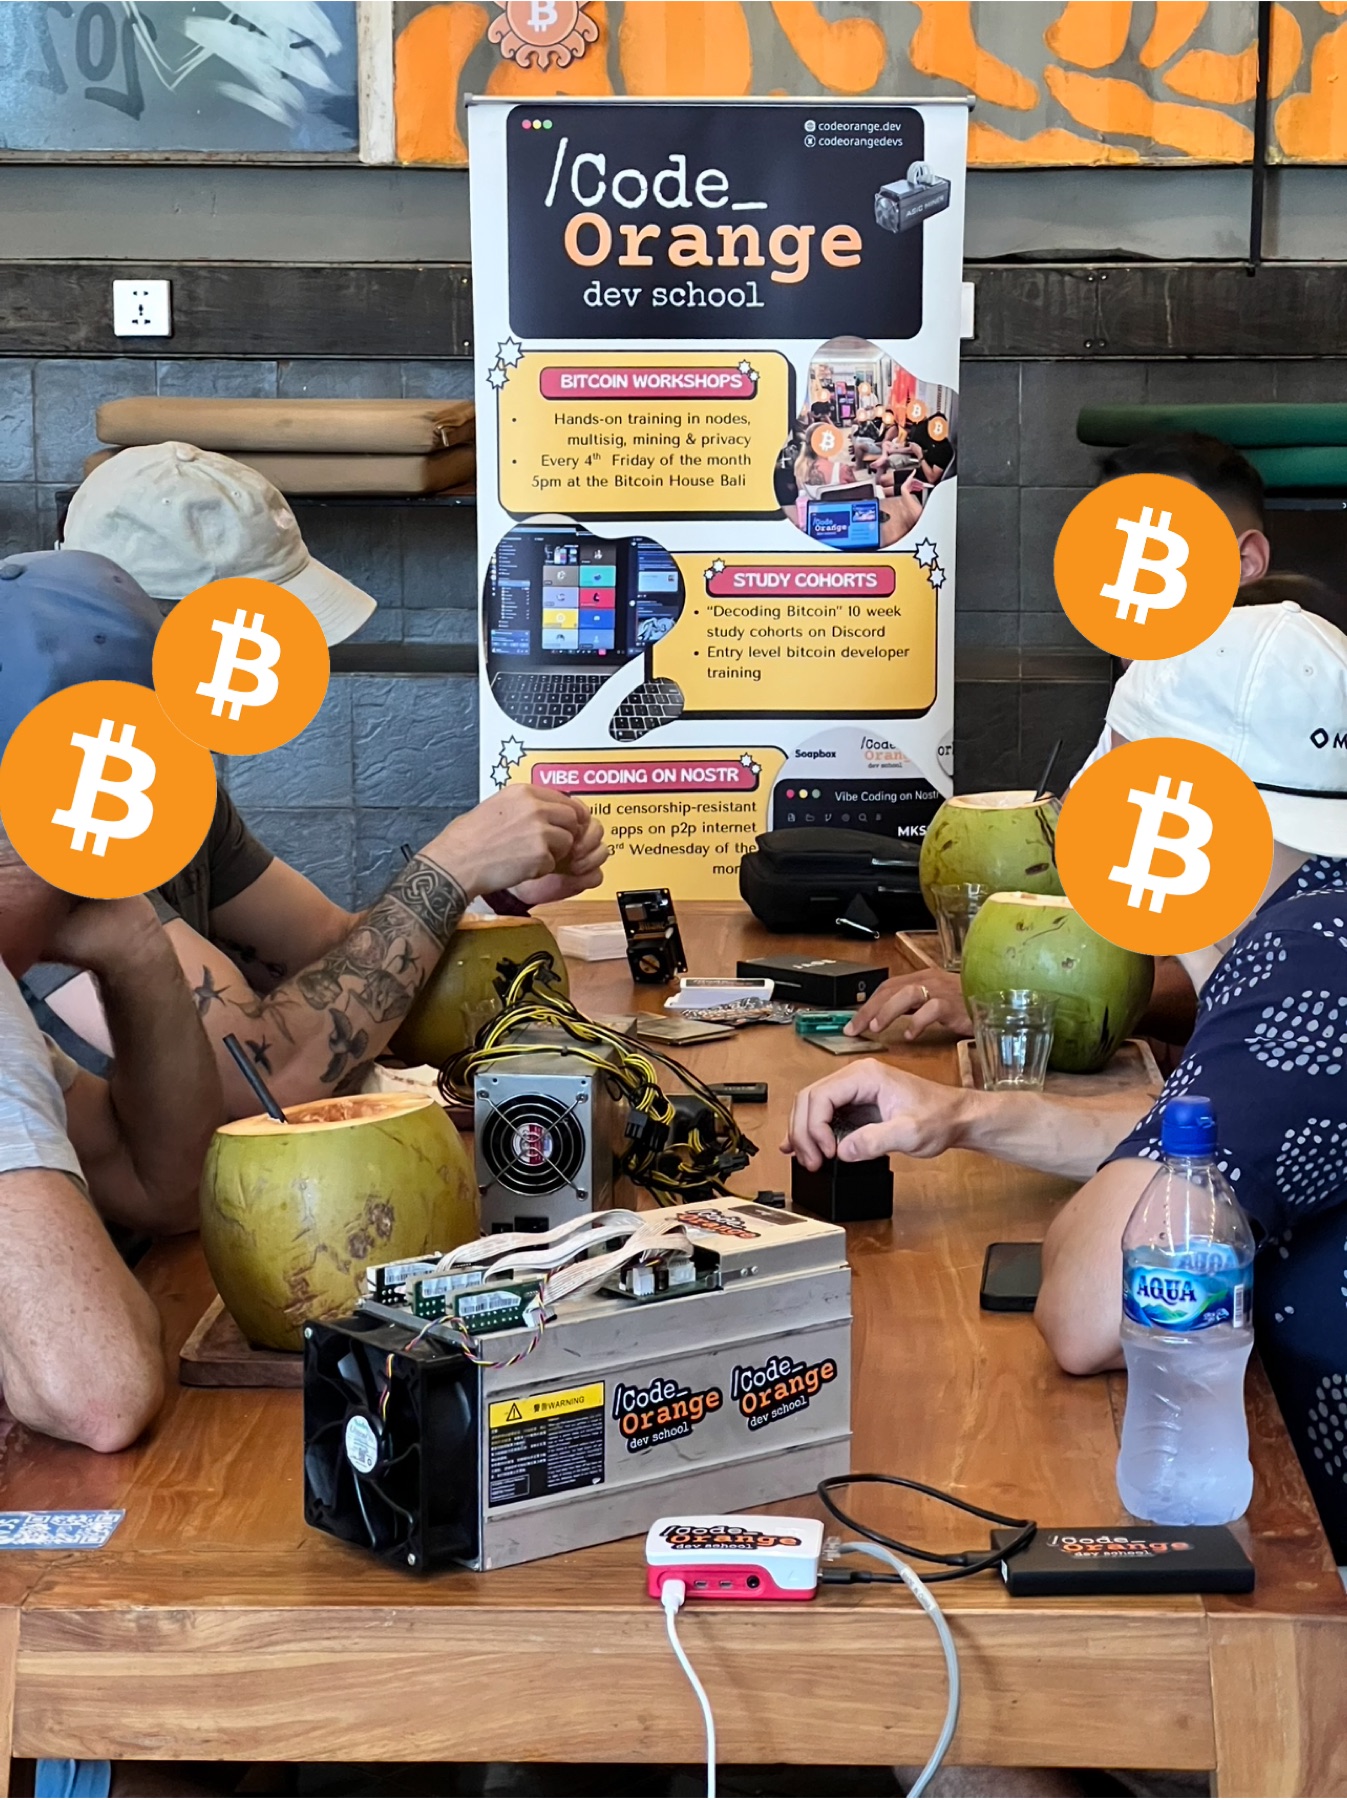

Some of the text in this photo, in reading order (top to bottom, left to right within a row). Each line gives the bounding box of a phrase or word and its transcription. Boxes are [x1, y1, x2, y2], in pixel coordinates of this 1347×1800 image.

[818, 120, 902, 134] codeorange.dev
[818, 135, 903, 149] codeorangedevs
[544, 136, 768, 211] /Code_
[563, 211, 863, 284] Orange
[583, 280, 765, 308] dev school
[560, 372, 744, 390] BITCOIN WORKSHOPS
[554, 412, 751, 430] Hands-on training in nodes,
[566, 432, 752, 450] multisig, mining & privacy
[541, 454, 580, 470] Every
[611, 453, 656, 470] Friday
[659, 453, 675, 467] of
[679, 453, 702, 467] the
[706, 453, 752, 467] month
[531, 474, 747, 491] 5pm at the Bitcoin House Bali
[733, 572, 878, 588] STUDY COHORTS
[847, 605, 861, 618] 10
[866, 604, 902, 618] week
[706, 625, 886, 642] study cohorts on Discord
[706, 645, 910, 662] Entry level bitcoin developer
[706, 665, 762, 682] training
[795, 749, 836, 760] Soapbox
[539, 767, 740, 786] VIBE CODING ON NOSTR
[835, 791, 858, 802] Vibe
[861, 790, 898, 803] Coding
[899, 793, 913, 801] on
[616, 800, 757, 818] censorship-resistant
[610, 821, 757, 839] apps on p2p internet
[628, 840, 710, 858] Wednesday
[714, 841, 729, 855] of
[734, 840, 757, 855] the
[1136, 1275, 1197, 1306] AQUA
[732, 1358, 804, 1397] /Code_
[741, 1362, 835, 1414] Orange
[614, 1380, 689, 1416] /Code_
[621, 1391, 720, 1435] Orange
[749, 1396, 808, 1428] dev school
[629, 1421, 690, 1450] dev school
[671, 1534, 800, 1546] Orange
[705, 1542, 753, 1550] school
[1063, 1542, 1190, 1554] Orange
